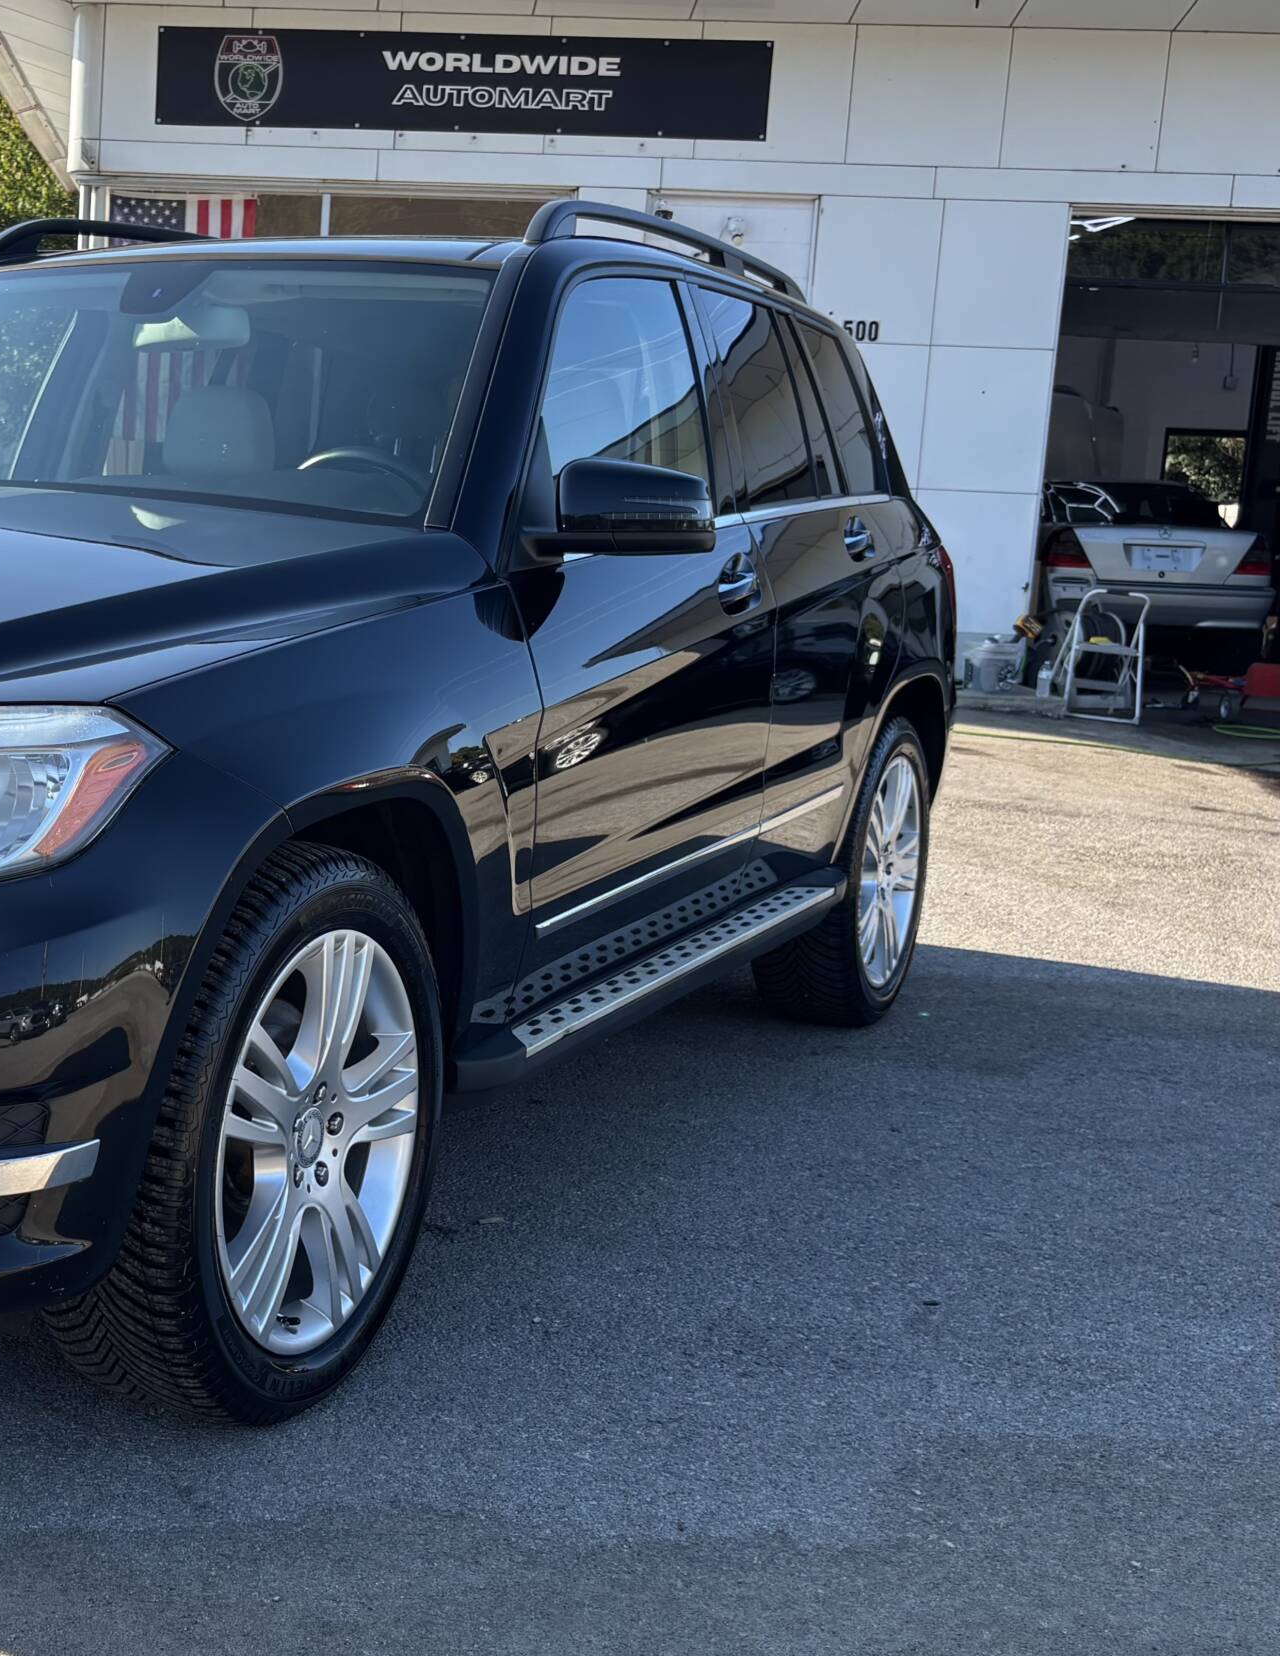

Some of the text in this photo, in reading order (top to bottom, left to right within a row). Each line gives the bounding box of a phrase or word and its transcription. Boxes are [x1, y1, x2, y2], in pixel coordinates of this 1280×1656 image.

[218, 54, 279, 62] WORLDWIDE
[382, 51, 621, 76] WORLDWIDE
[392, 84, 613, 111] AUTOMART
